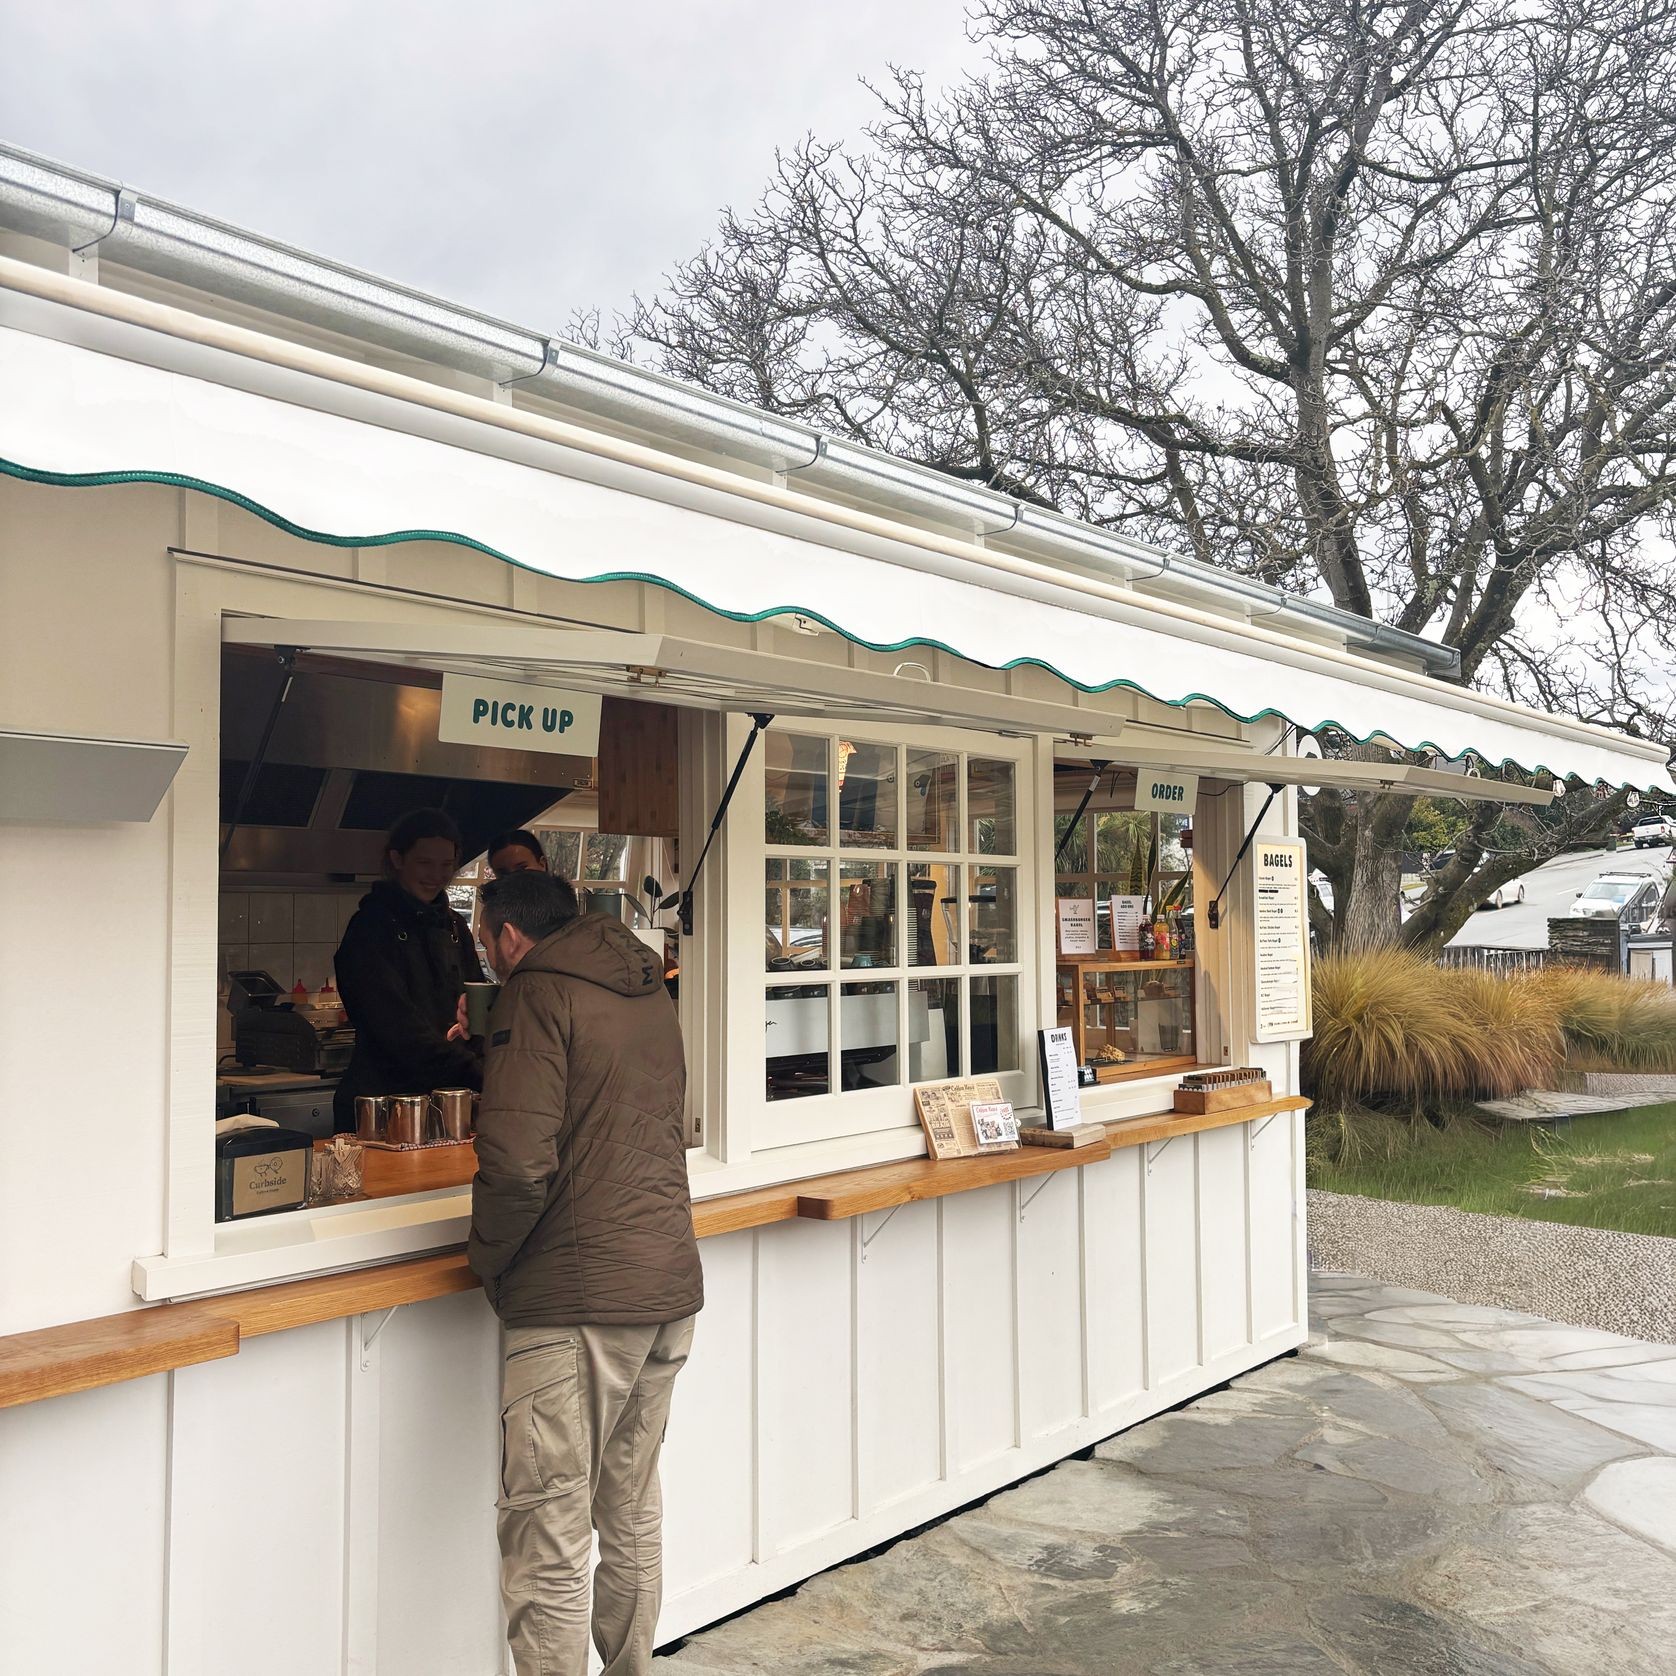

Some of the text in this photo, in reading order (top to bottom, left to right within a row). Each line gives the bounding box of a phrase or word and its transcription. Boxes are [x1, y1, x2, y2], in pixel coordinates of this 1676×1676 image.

[472, 698, 574, 734] PICK UP
[1151, 782, 1184, 802] ORDER
[1263, 853, 1293, 868] BAGELS
[249, 1176, 287, 1190] Curbside
